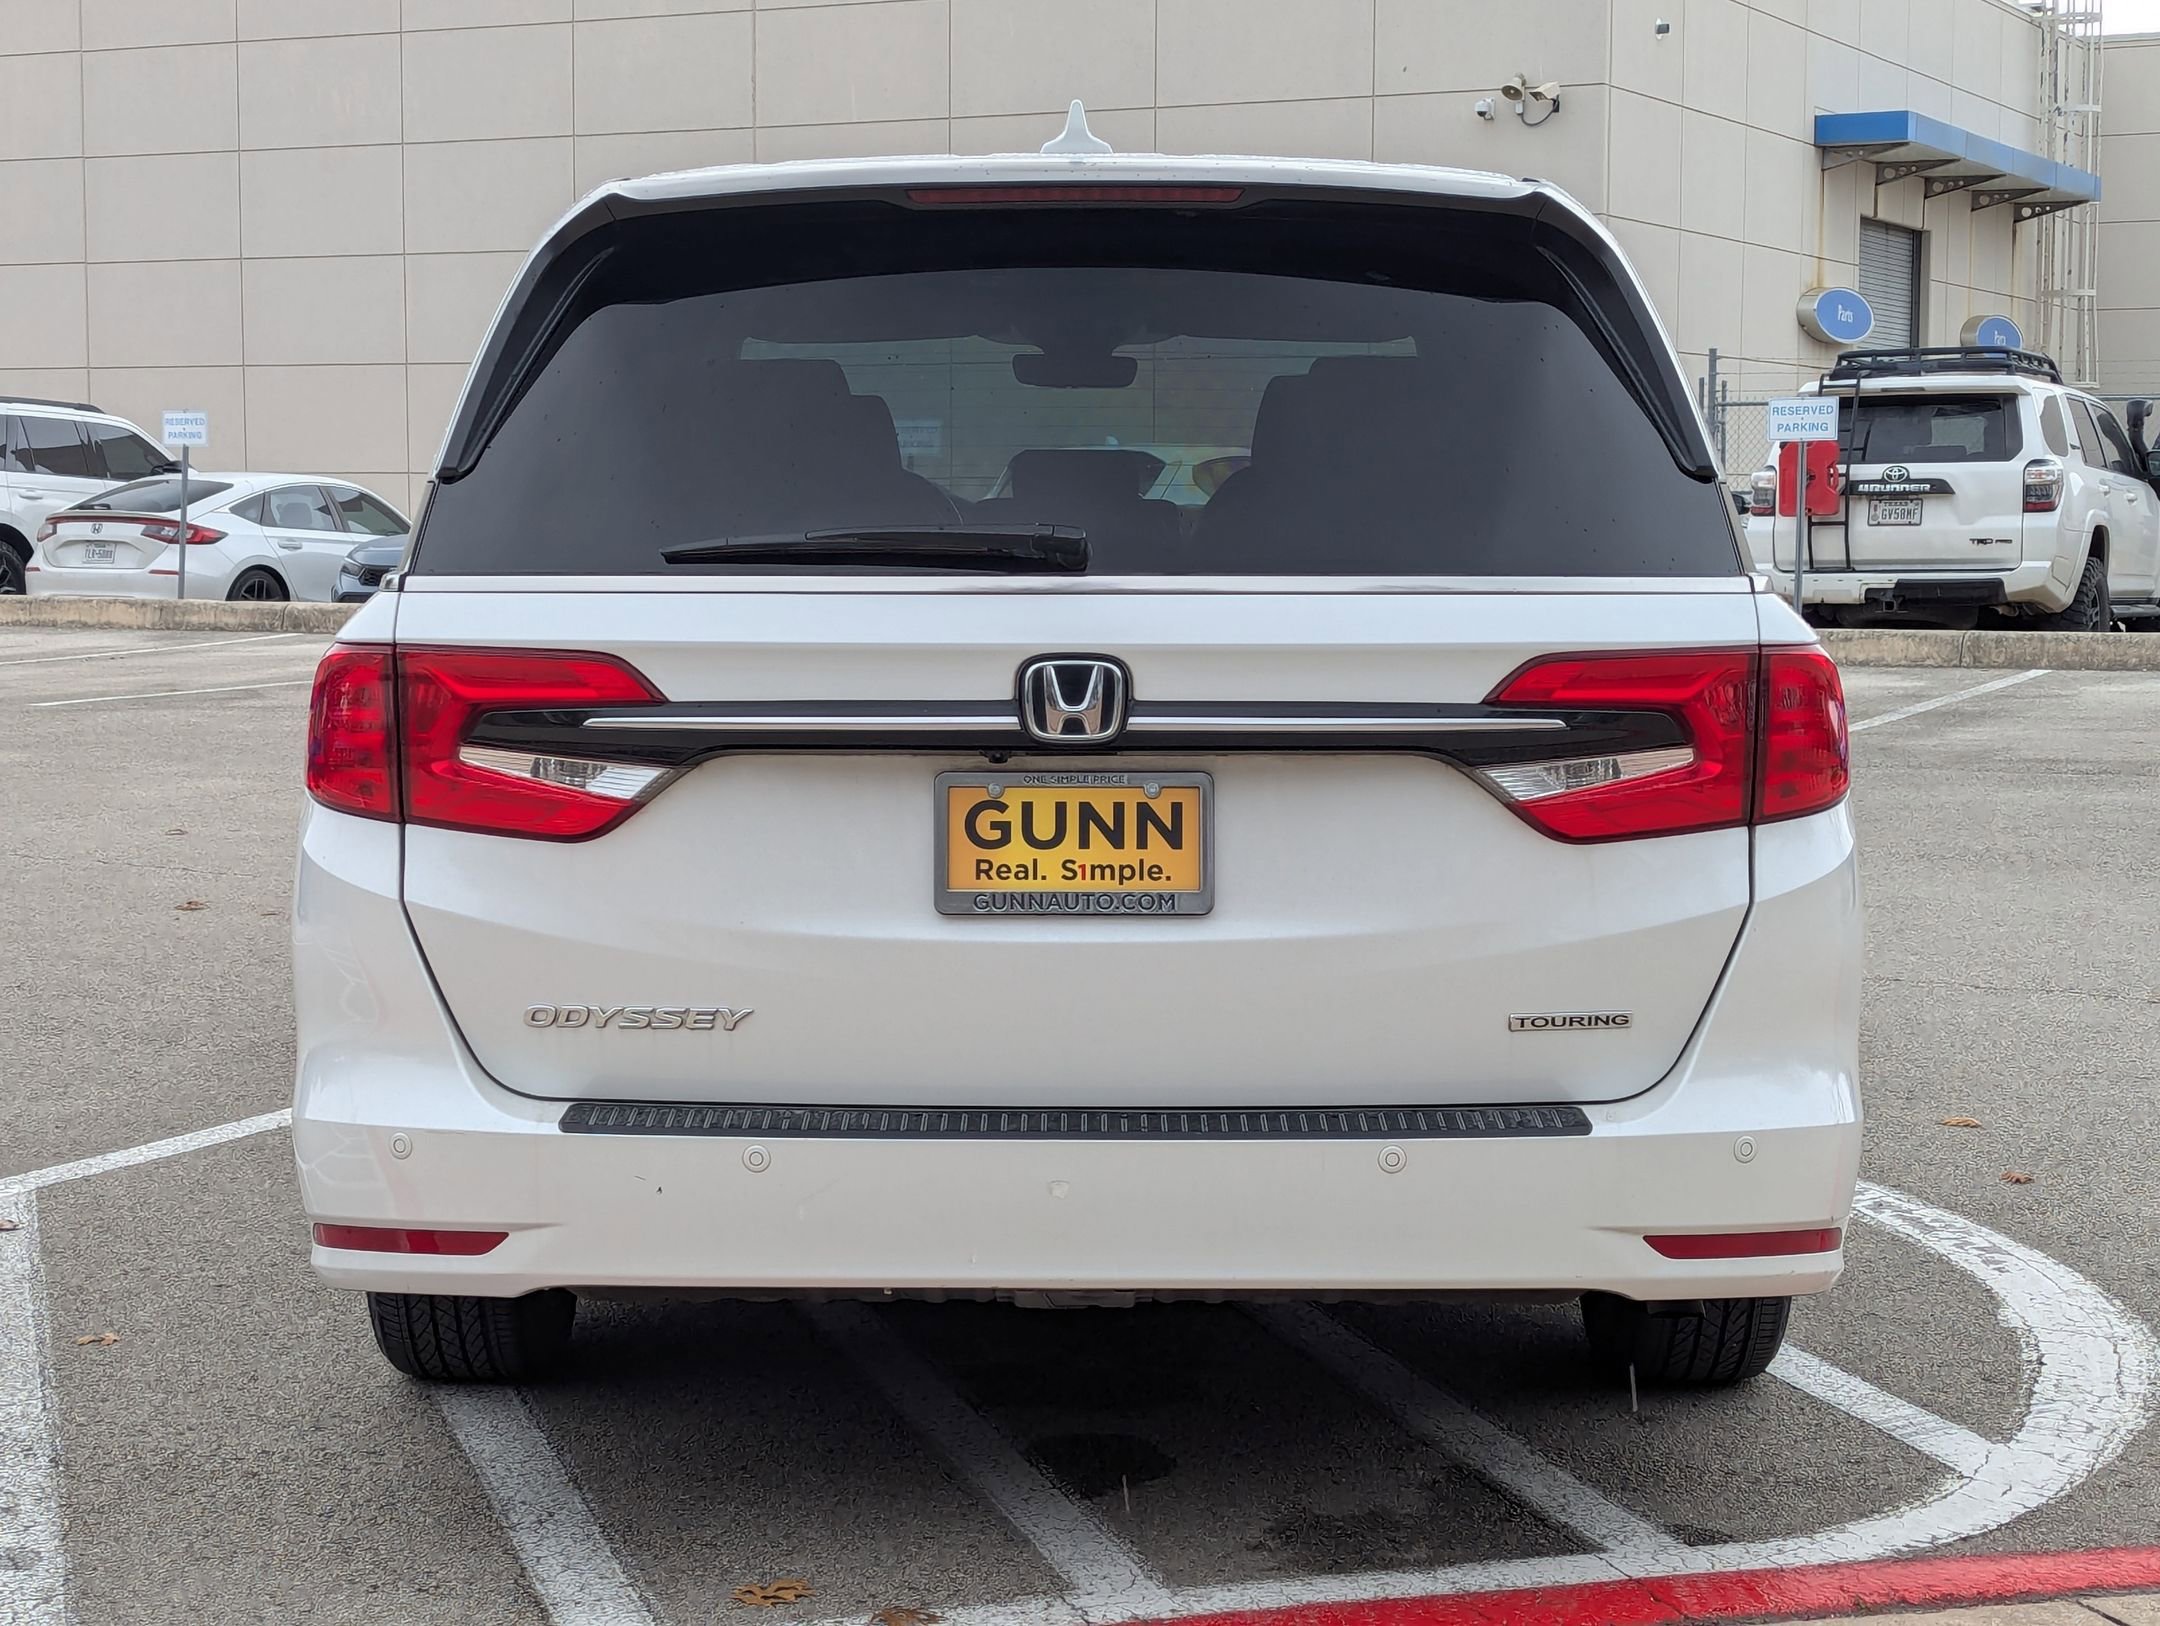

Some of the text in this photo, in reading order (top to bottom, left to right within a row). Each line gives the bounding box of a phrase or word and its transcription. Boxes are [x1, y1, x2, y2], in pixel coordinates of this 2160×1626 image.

[1772, 404, 1834, 416] RESERVED
[1777, 422, 1829, 432] PARKING
[168, 431, 202, 440] PARKING
[1023, 775, 1126, 785] ONE SIMPLE PRICE
[964, 799, 1184, 850] GUNN
[974, 858, 1048, 881] Real.
[973, 892, 1177, 912] GUNNAUTO.COM
[523, 1003, 755, 1031] ODYSSEY
[1513, 1014, 1630, 1028] TOURING
